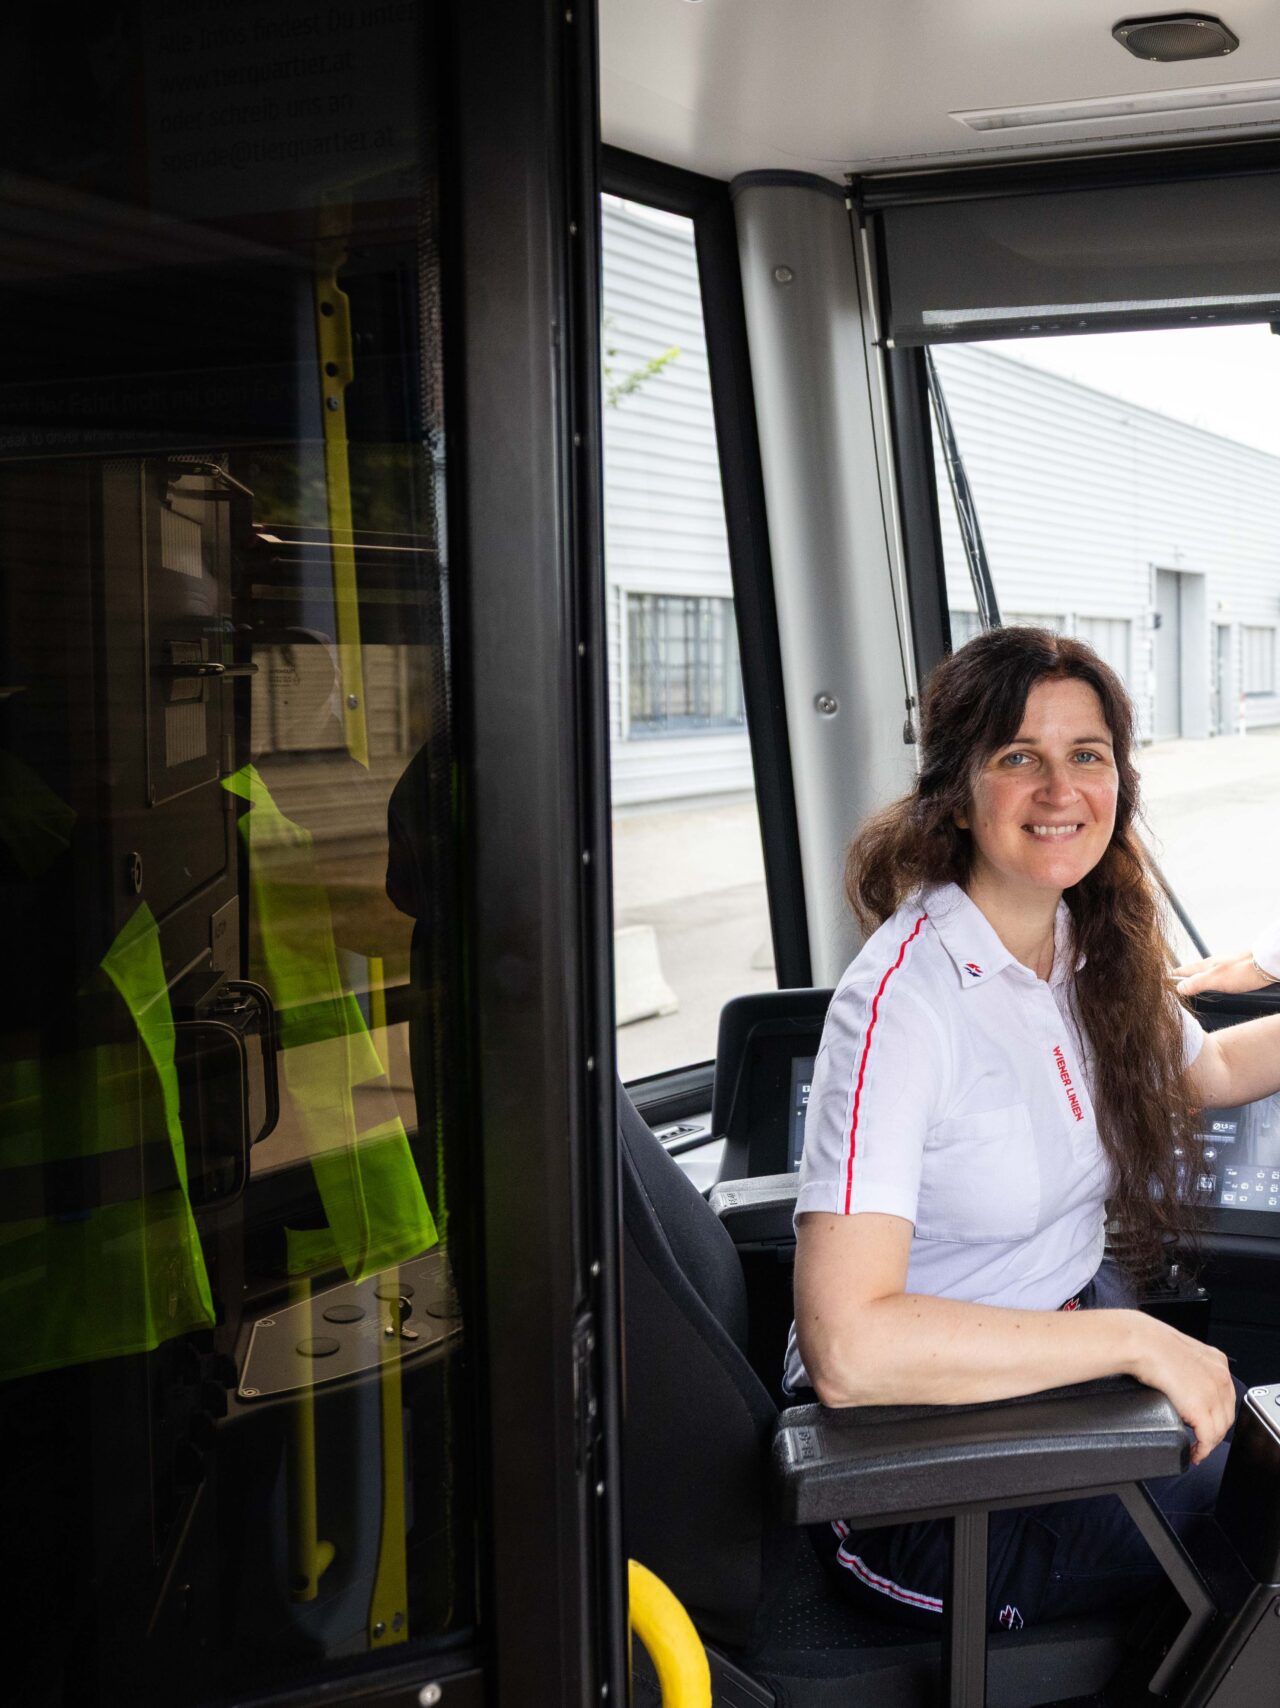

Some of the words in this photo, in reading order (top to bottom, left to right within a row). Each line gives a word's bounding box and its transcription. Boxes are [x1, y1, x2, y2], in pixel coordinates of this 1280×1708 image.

[328, 7, 354, 32] Du
[160, 108, 203, 134] oder
[208, 98, 280, 130] schreib
[328, 94, 353, 114] an
[1053, 1045, 1072, 1086] WIENER
[1066, 1088, 1084, 1121] LINIEN
